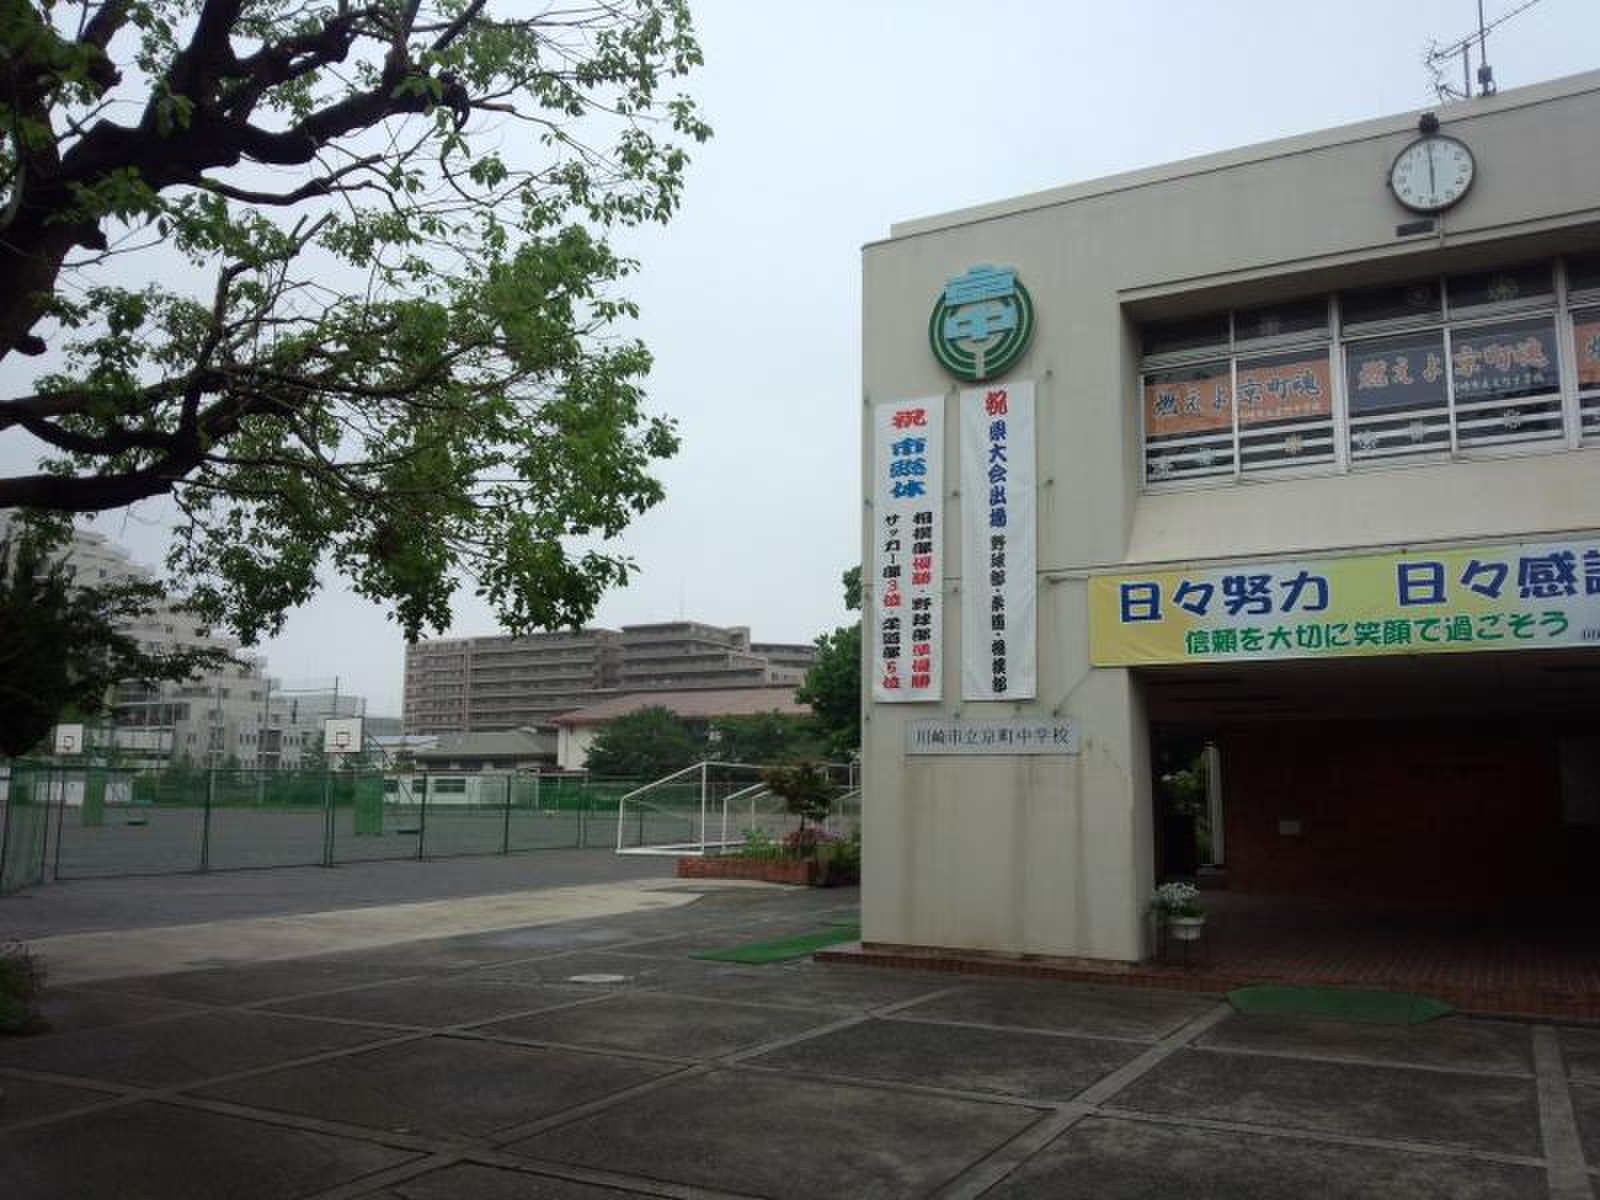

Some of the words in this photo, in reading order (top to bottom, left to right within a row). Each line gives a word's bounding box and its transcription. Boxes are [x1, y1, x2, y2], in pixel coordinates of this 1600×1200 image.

[894, 409, 928, 430] 祝
[986, 391, 1008, 416] 祝
[988, 420, 1008, 527] 県大会出場
[1120, 571, 1330, 623] 日々努力
[1185, 610, 1568, 655] 信頼を大切に笑顔で過ごそう
[916, 726, 1071, 746] 川崎市立京町中学校
